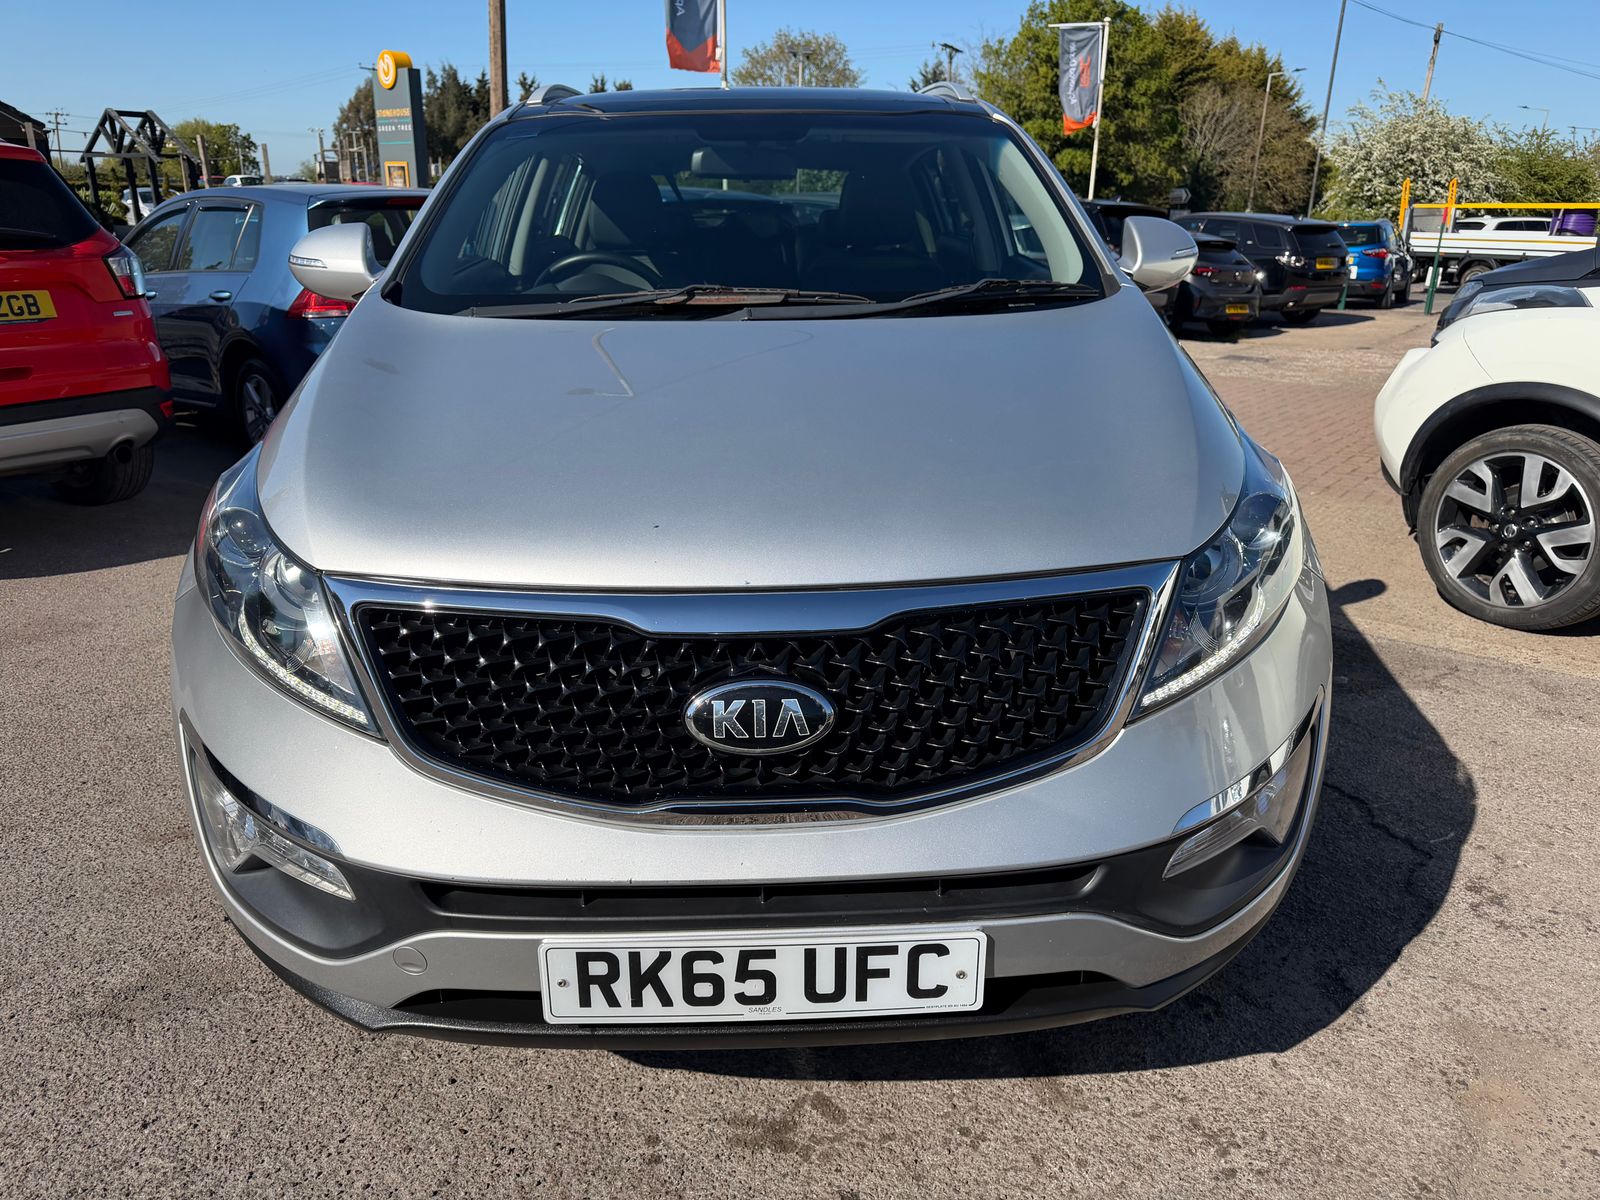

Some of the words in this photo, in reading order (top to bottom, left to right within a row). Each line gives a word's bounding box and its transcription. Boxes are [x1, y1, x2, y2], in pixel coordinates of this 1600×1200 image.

[711, 698, 810, 739] KIA
[576, 949, 776, 1008] RK65
[804, 943, 950, 1003] UFC
